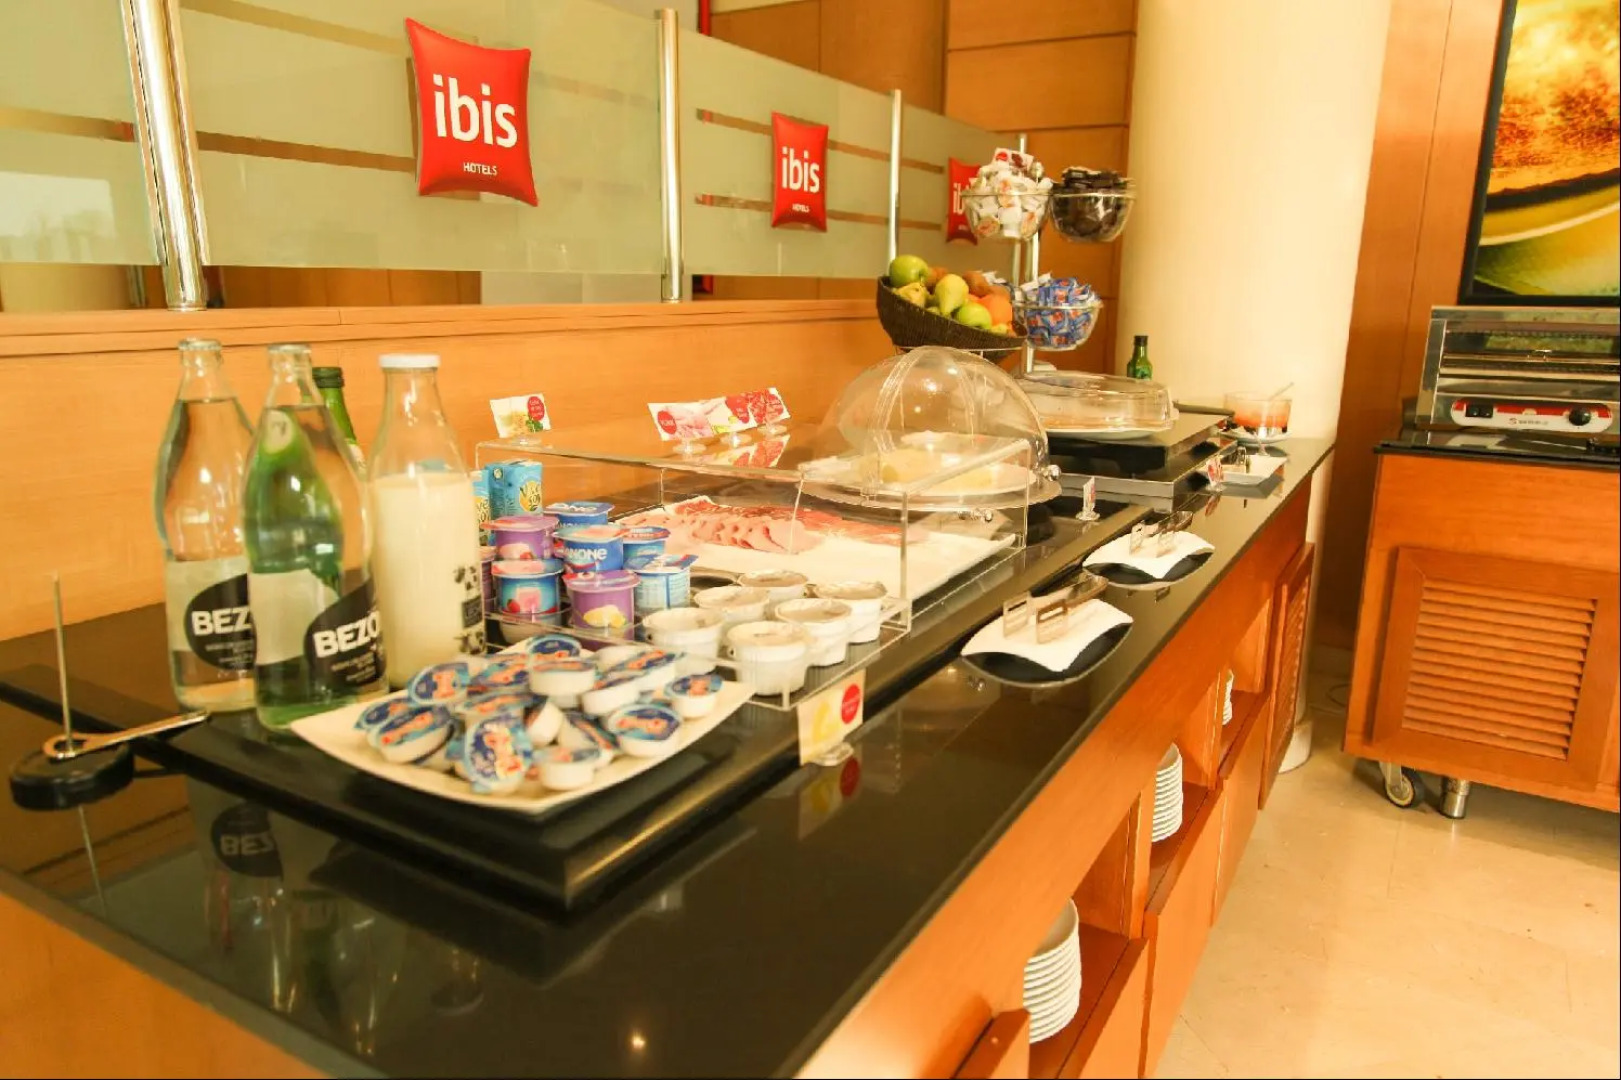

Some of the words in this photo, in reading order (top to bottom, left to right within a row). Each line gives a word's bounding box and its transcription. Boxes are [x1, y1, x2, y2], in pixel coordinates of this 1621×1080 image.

[433, 73, 517, 148] ibis
[463, 162, 497, 176] HOTELS
[782, 146, 820, 194] ibis
